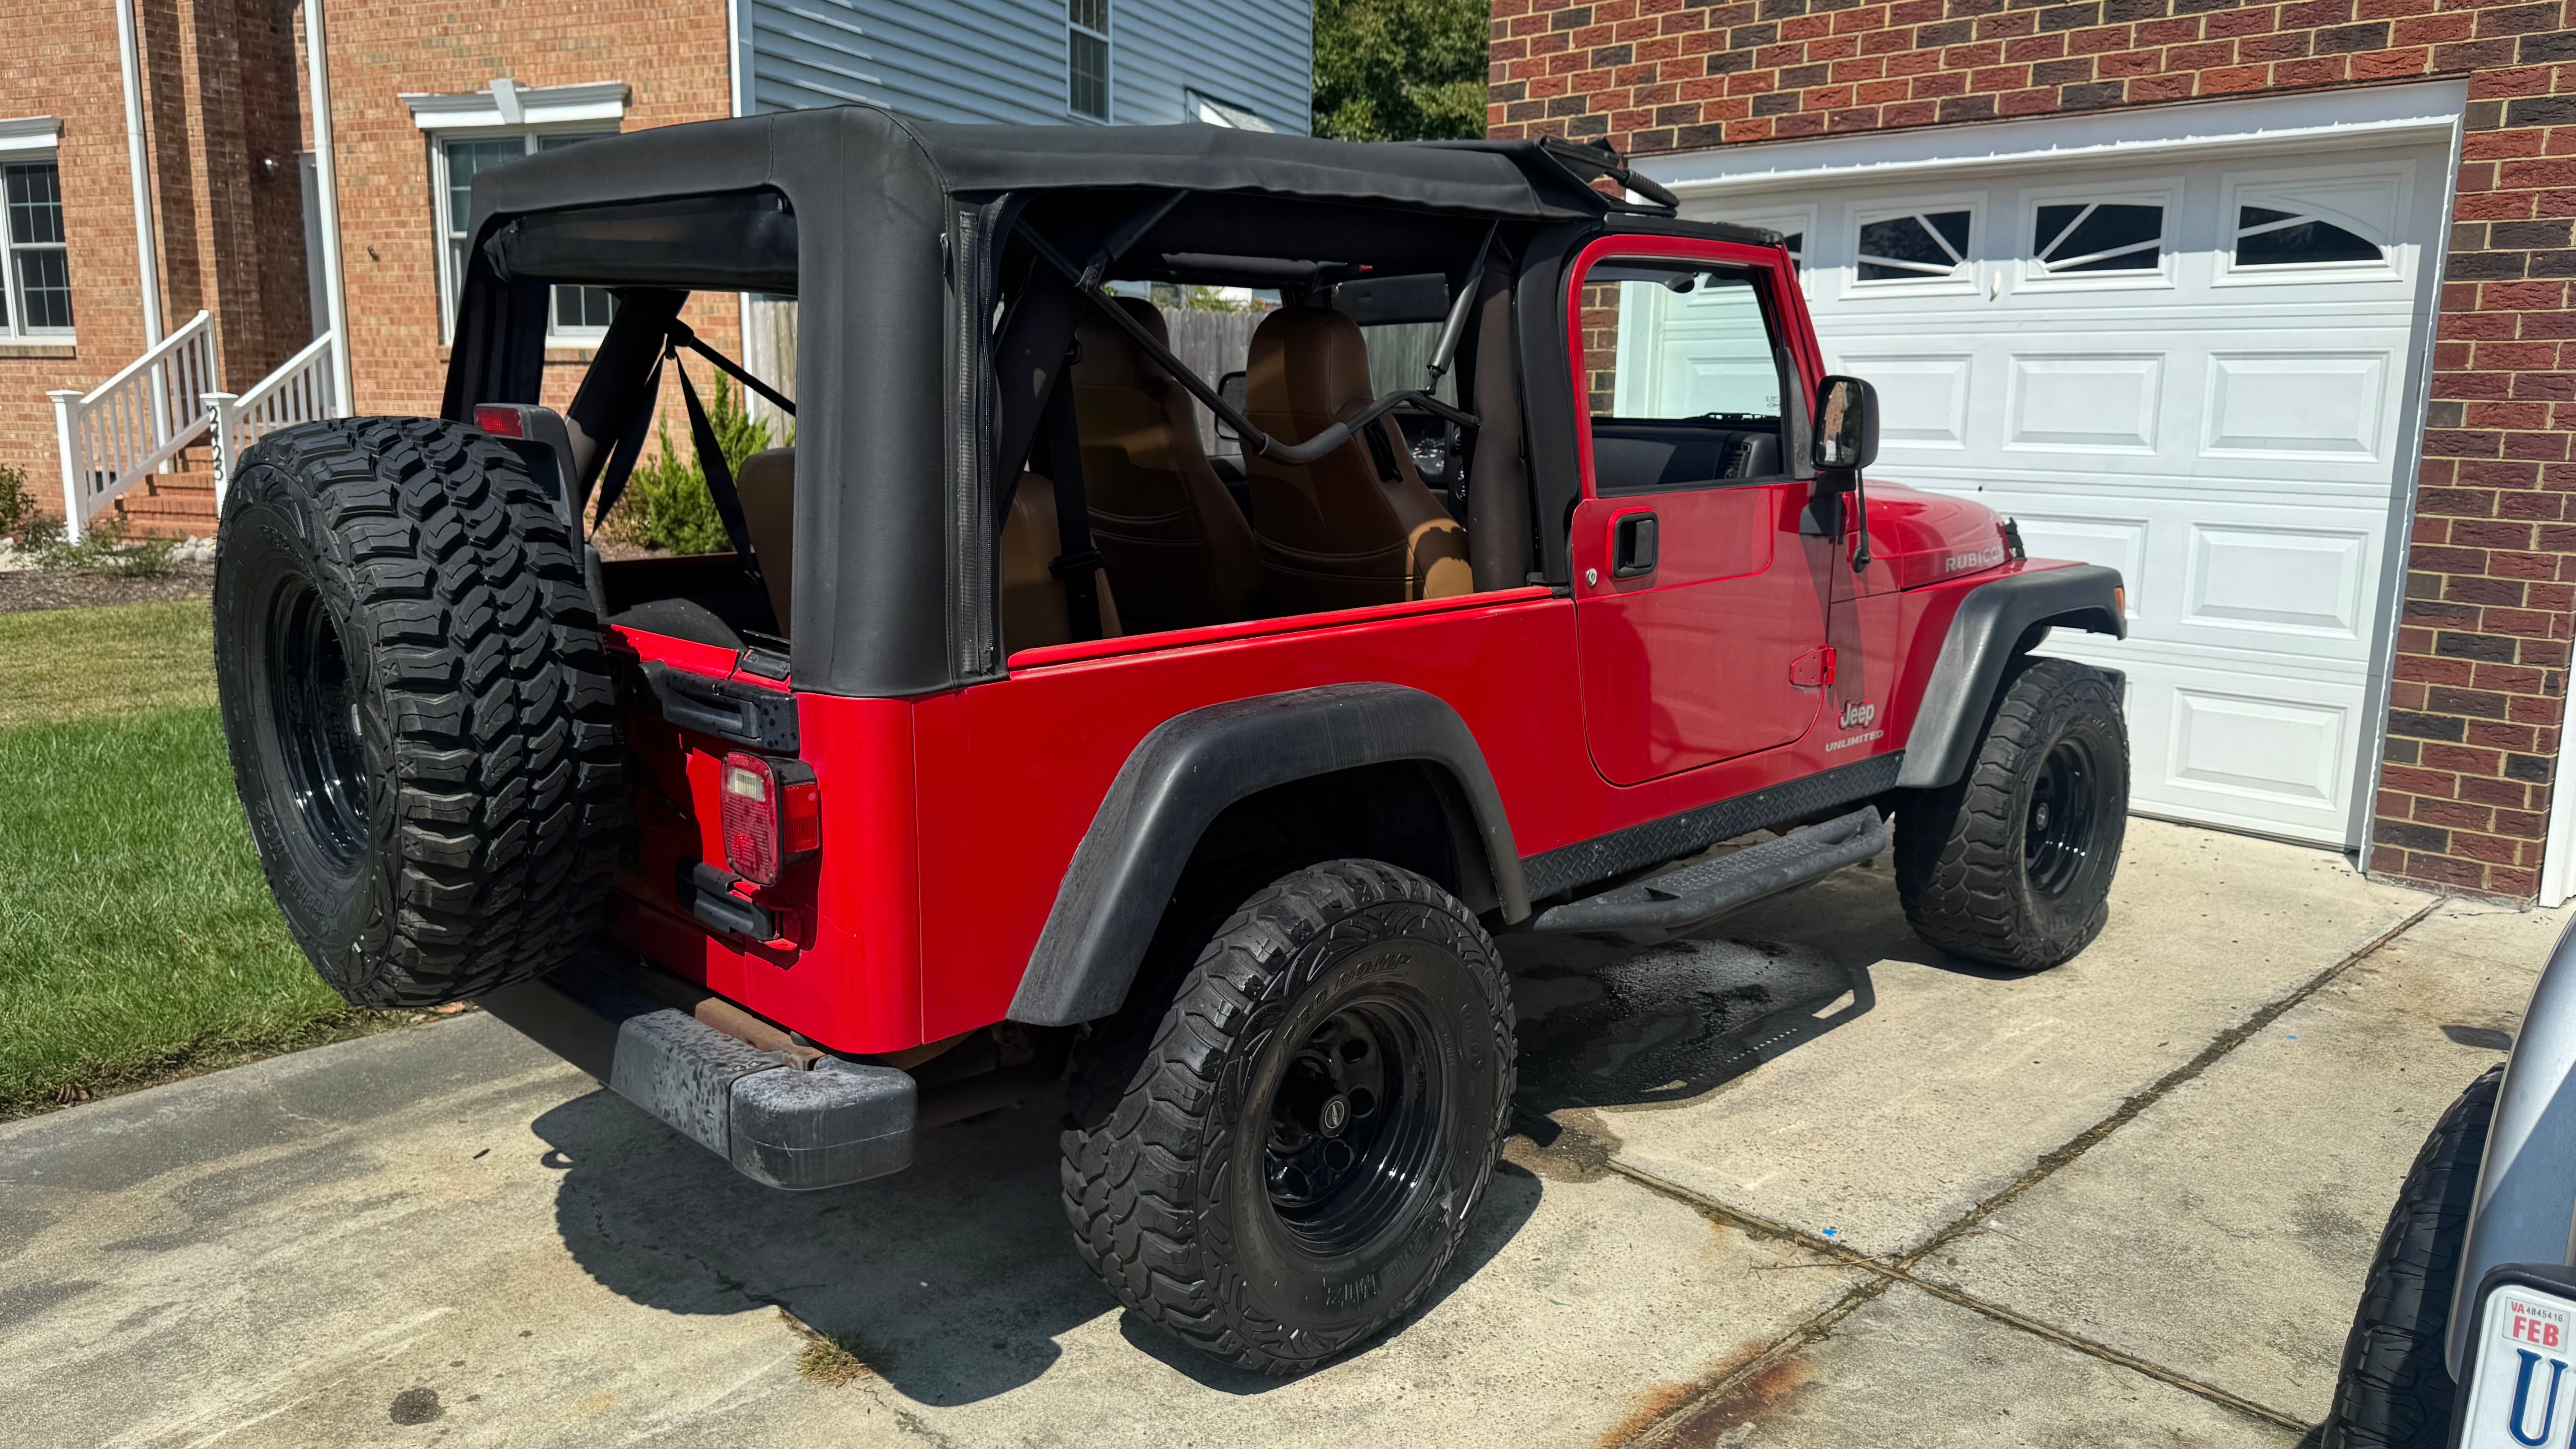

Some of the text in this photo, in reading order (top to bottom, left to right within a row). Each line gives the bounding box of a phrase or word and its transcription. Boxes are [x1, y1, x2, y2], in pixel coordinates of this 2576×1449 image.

[1841, 703, 1875, 727] Jeep
[1825, 729, 1884, 752] UNLIMITED
[2511, 1301, 2525, 1314] VA
[2513, 1315, 2559, 1347] FEB
[2509, 1348, 2576, 1449] U
